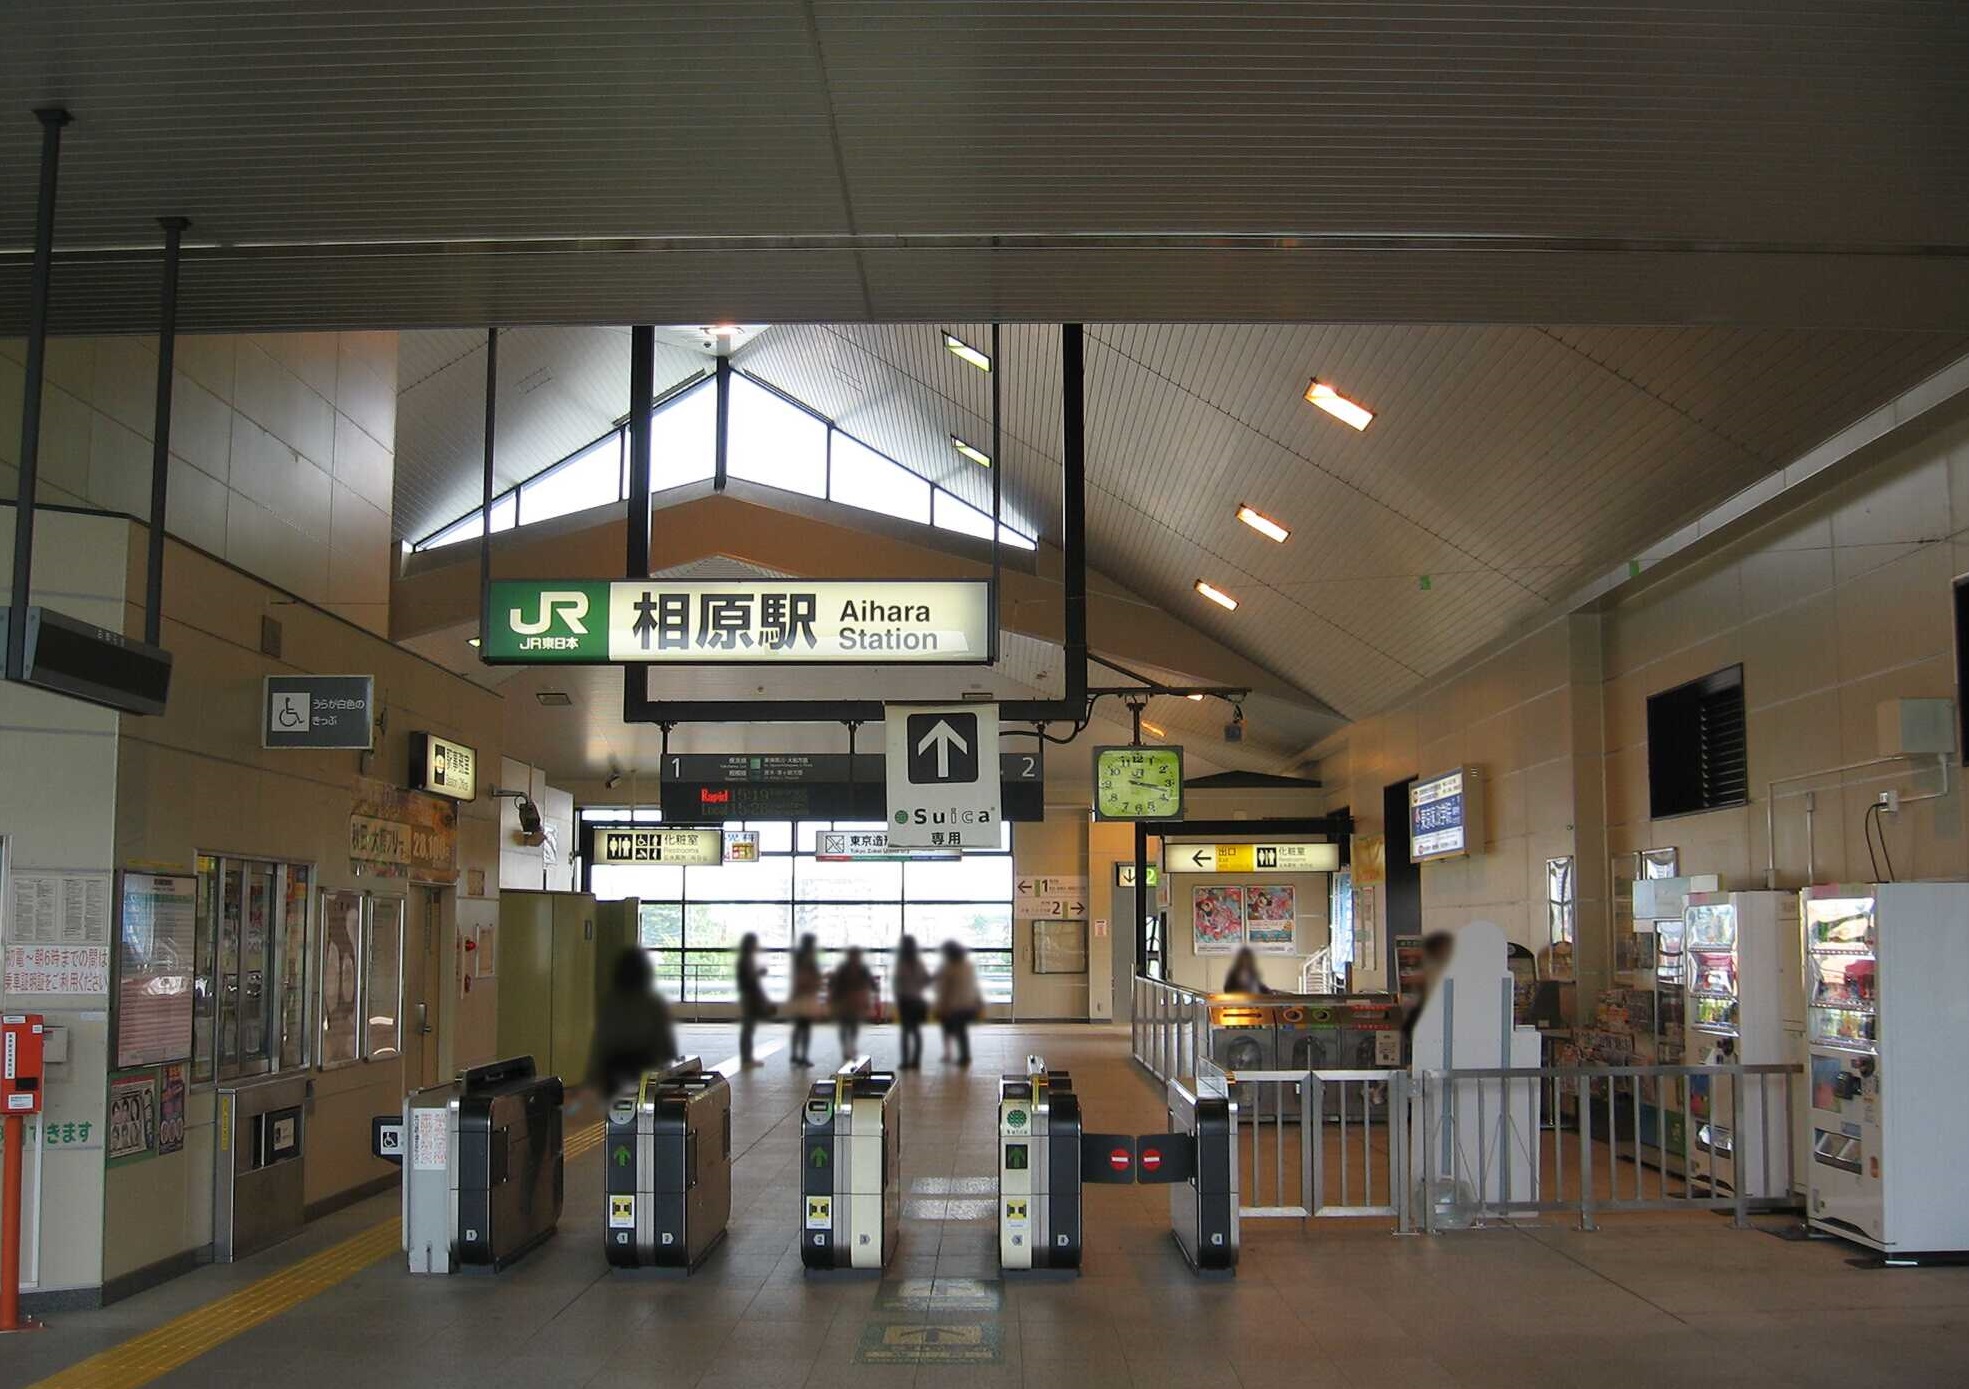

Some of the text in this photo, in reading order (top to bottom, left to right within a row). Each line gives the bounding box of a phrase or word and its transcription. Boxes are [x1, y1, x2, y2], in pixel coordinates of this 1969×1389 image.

[510, 591, 589, 635] JR
[840, 600, 930, 622] Aihara
[633, 592, 817, 650] 相原駅
[519, 637, 579, 650] JR東日本
[839, 627, 938, 650] Station
[671, 757, 681, 778] 1
[1022, 757, 1035, 778] 2
[914, 808, 990, 825] Suica
[664, 834, 700, 845] 化粧室
[931, 831, 961, 845] 専用
[1218, 847, 1236, 856] 出口
[1042, 879, 1048, 893] 1
[1052, 901, 1061, 915] 2
